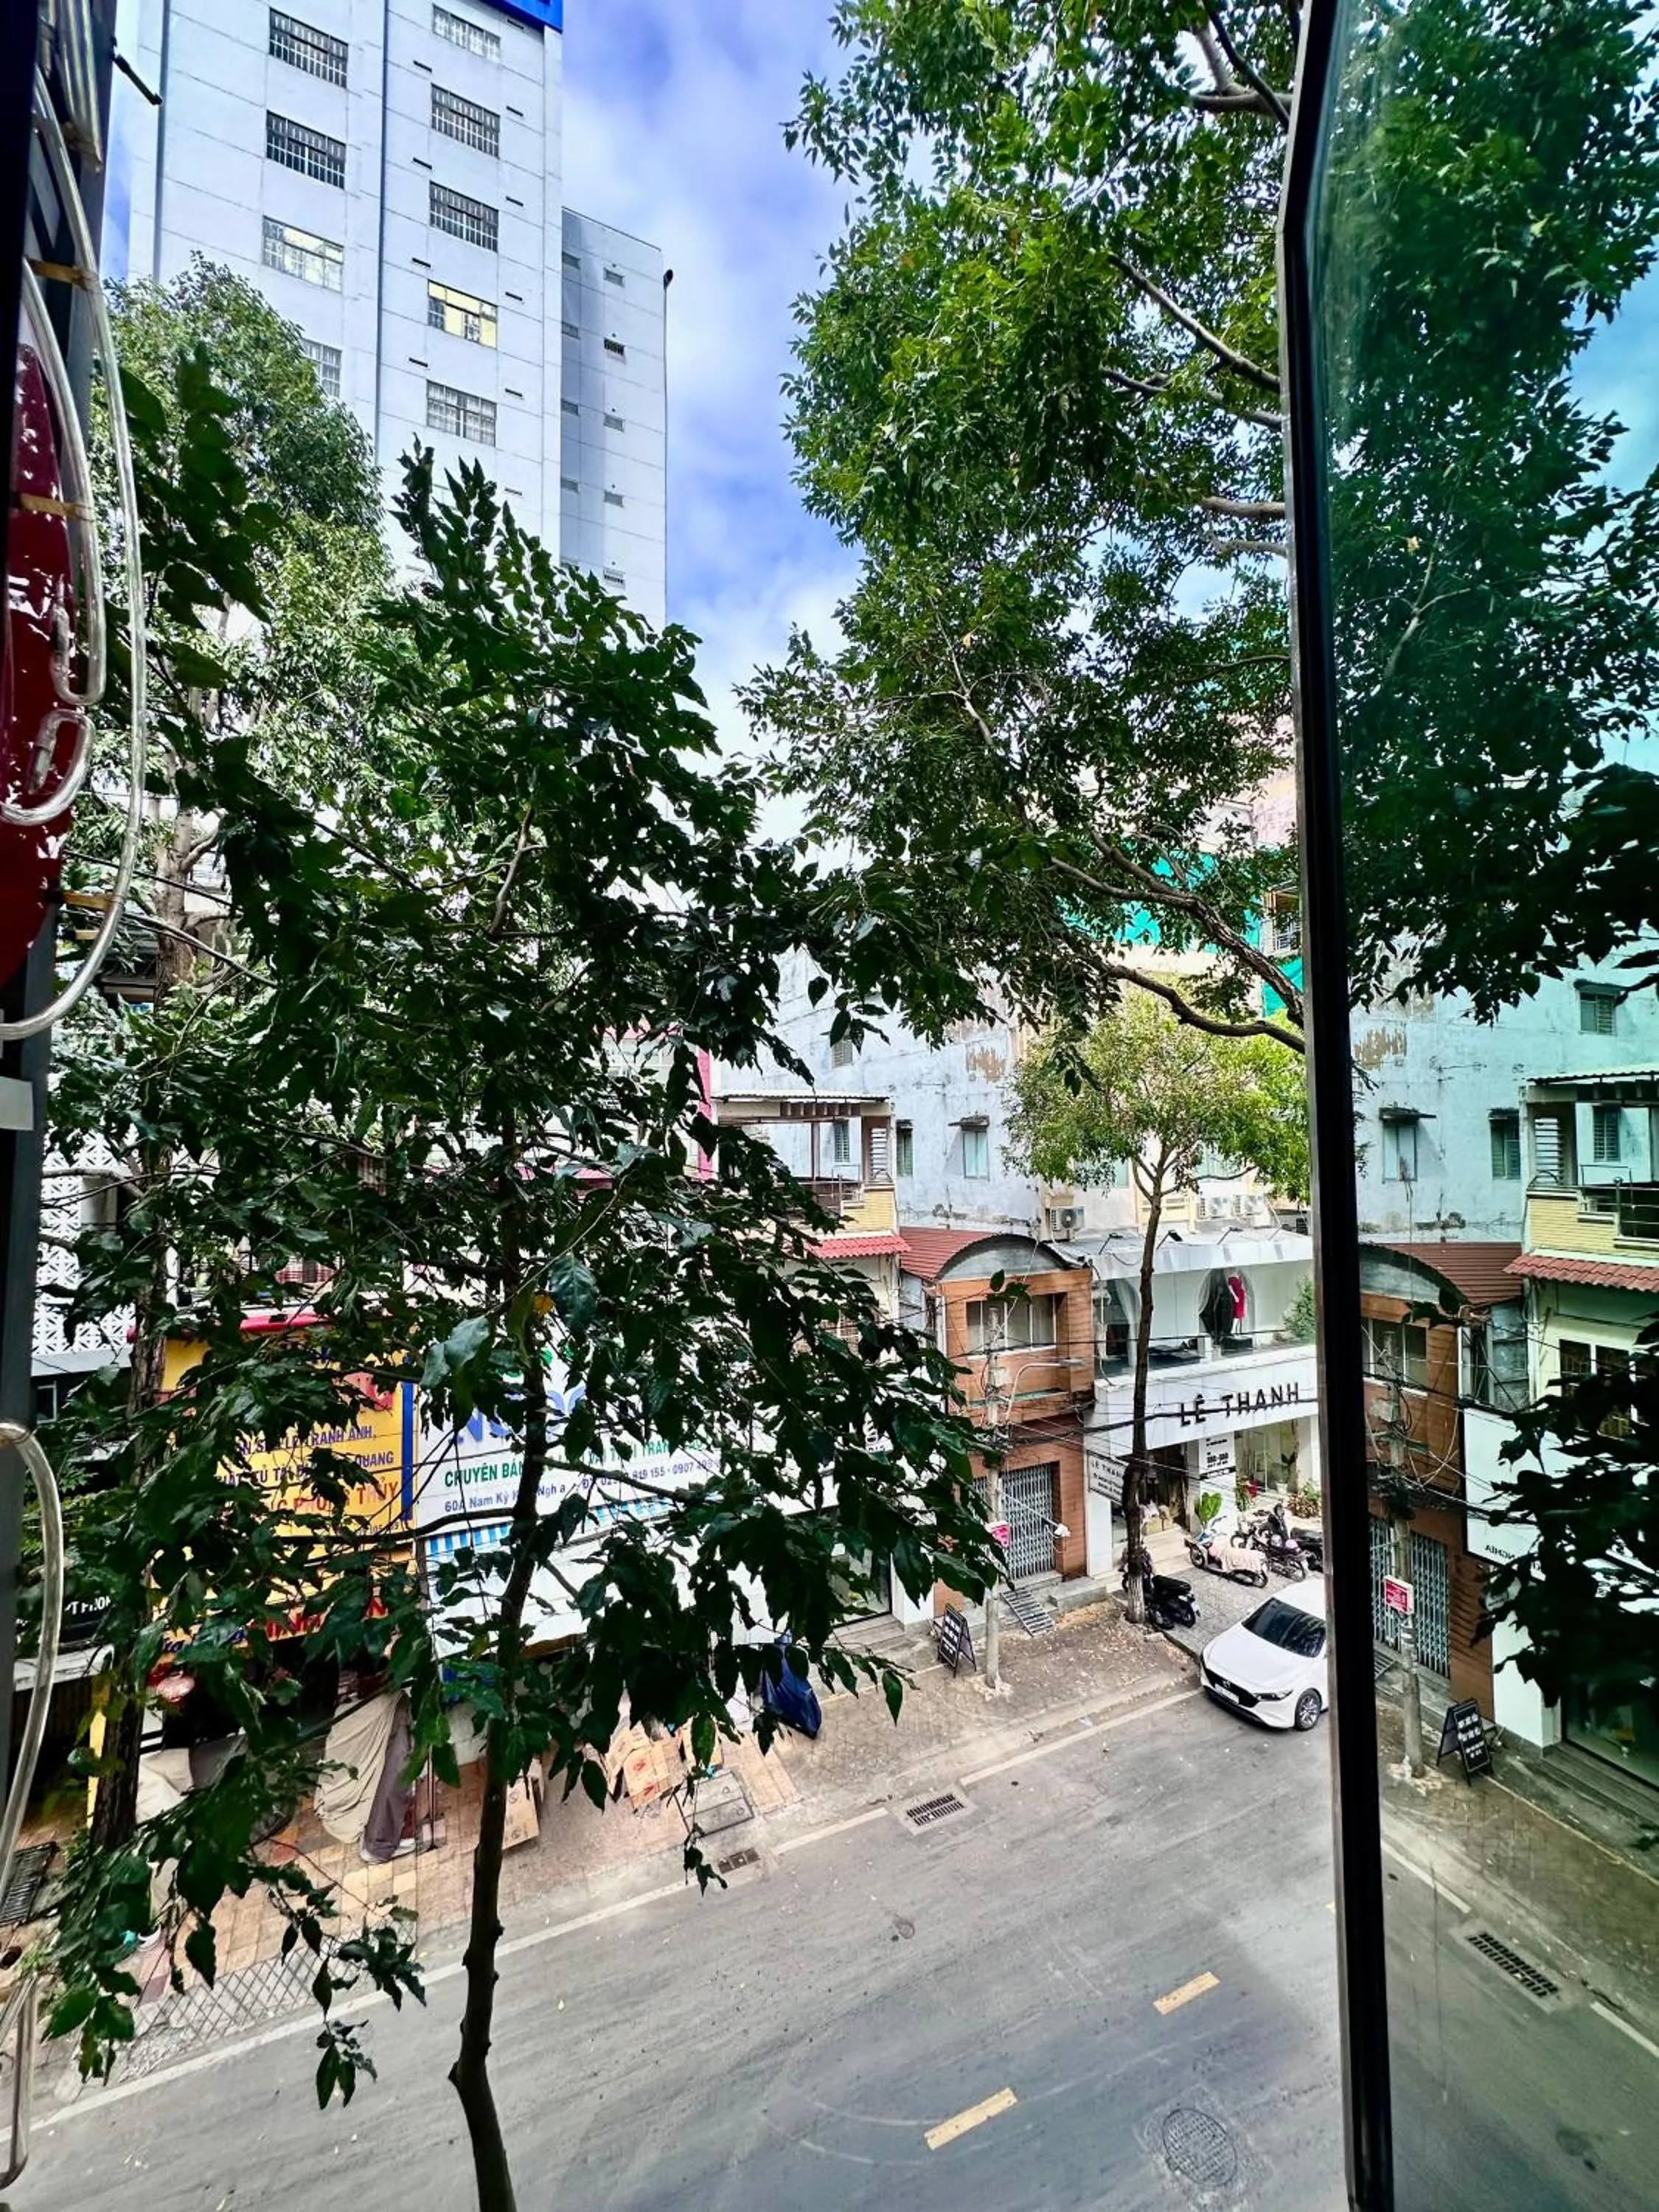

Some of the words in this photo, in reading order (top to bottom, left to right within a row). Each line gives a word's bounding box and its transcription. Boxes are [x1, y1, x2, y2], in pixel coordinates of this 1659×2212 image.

[1180, 1393, 1206, 1427] LÊ
[1221, 1382, 1298, 1418] THANH
[469, 1495, 493, 1509] Nam
